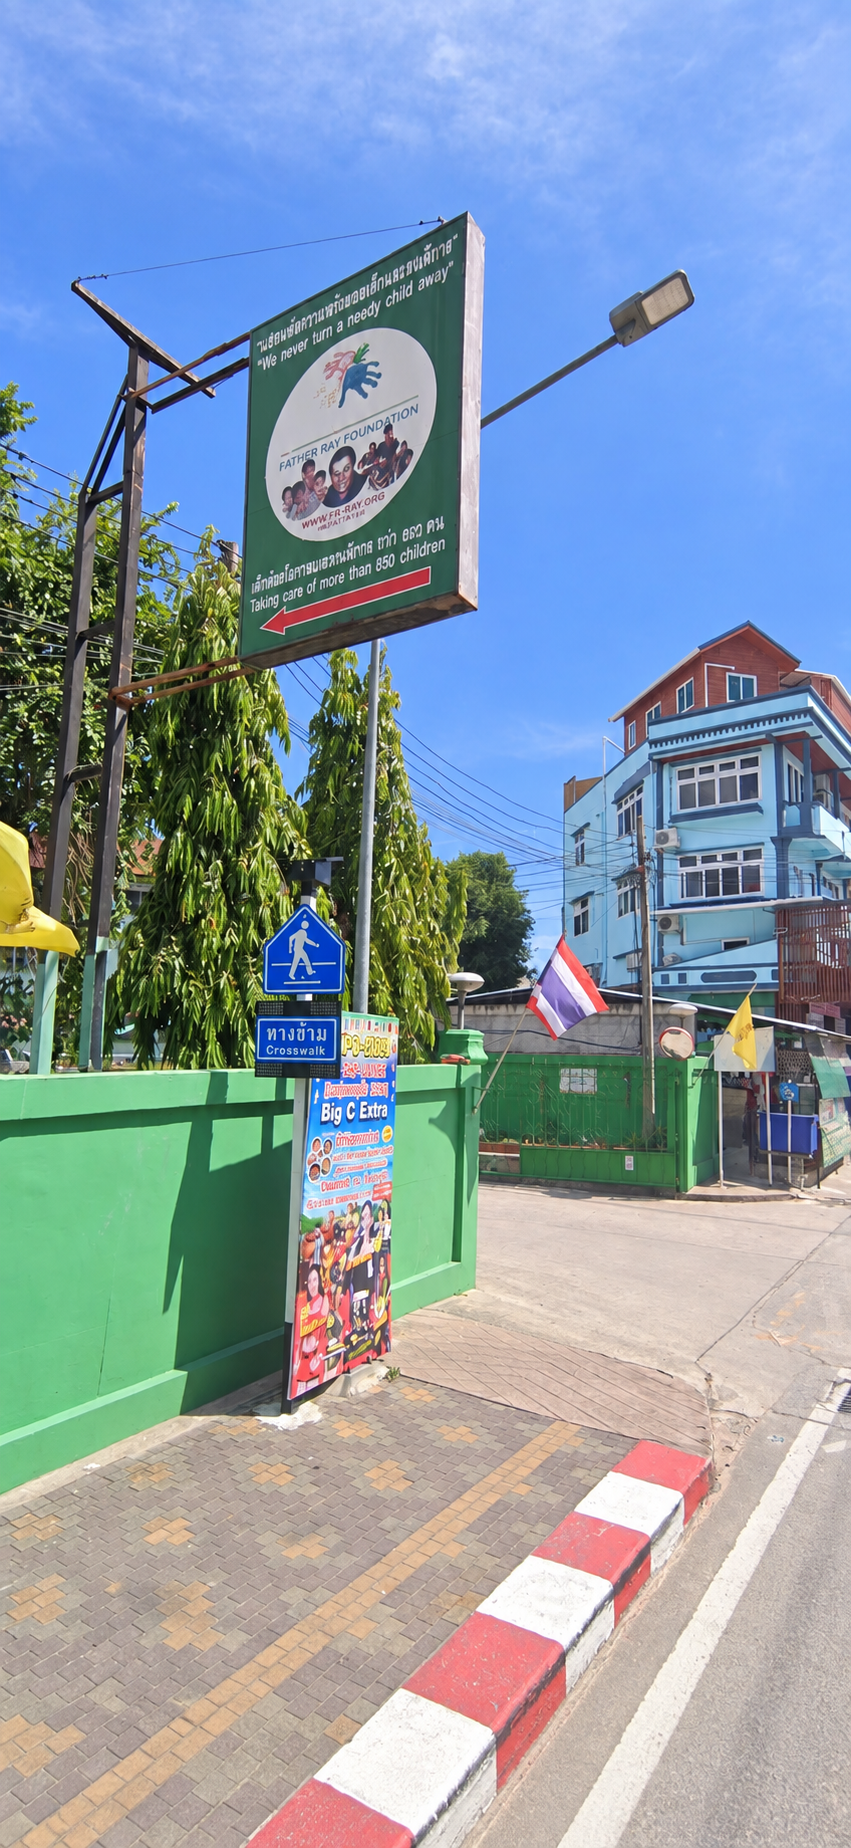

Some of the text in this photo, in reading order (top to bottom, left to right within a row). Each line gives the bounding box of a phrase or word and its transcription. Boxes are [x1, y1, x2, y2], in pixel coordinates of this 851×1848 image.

[280, 338, 309, 362] never
[312, 325, 333, 345] turn
[336, 320, 343, 333] a
[347, 299, 381, 328] needy
[385, 280, 413, 308] child
[279, 403, 419, 472] FATHER RAY FOUNDATION
[249, 539, 446, 613] Taking care of more than 850 children
[266, 1022, 327, 1042] ทางข้าม
[266, 1045, 326, 1056] Crosswalk
[321, 1101, 388, 1126] Big C Extra
